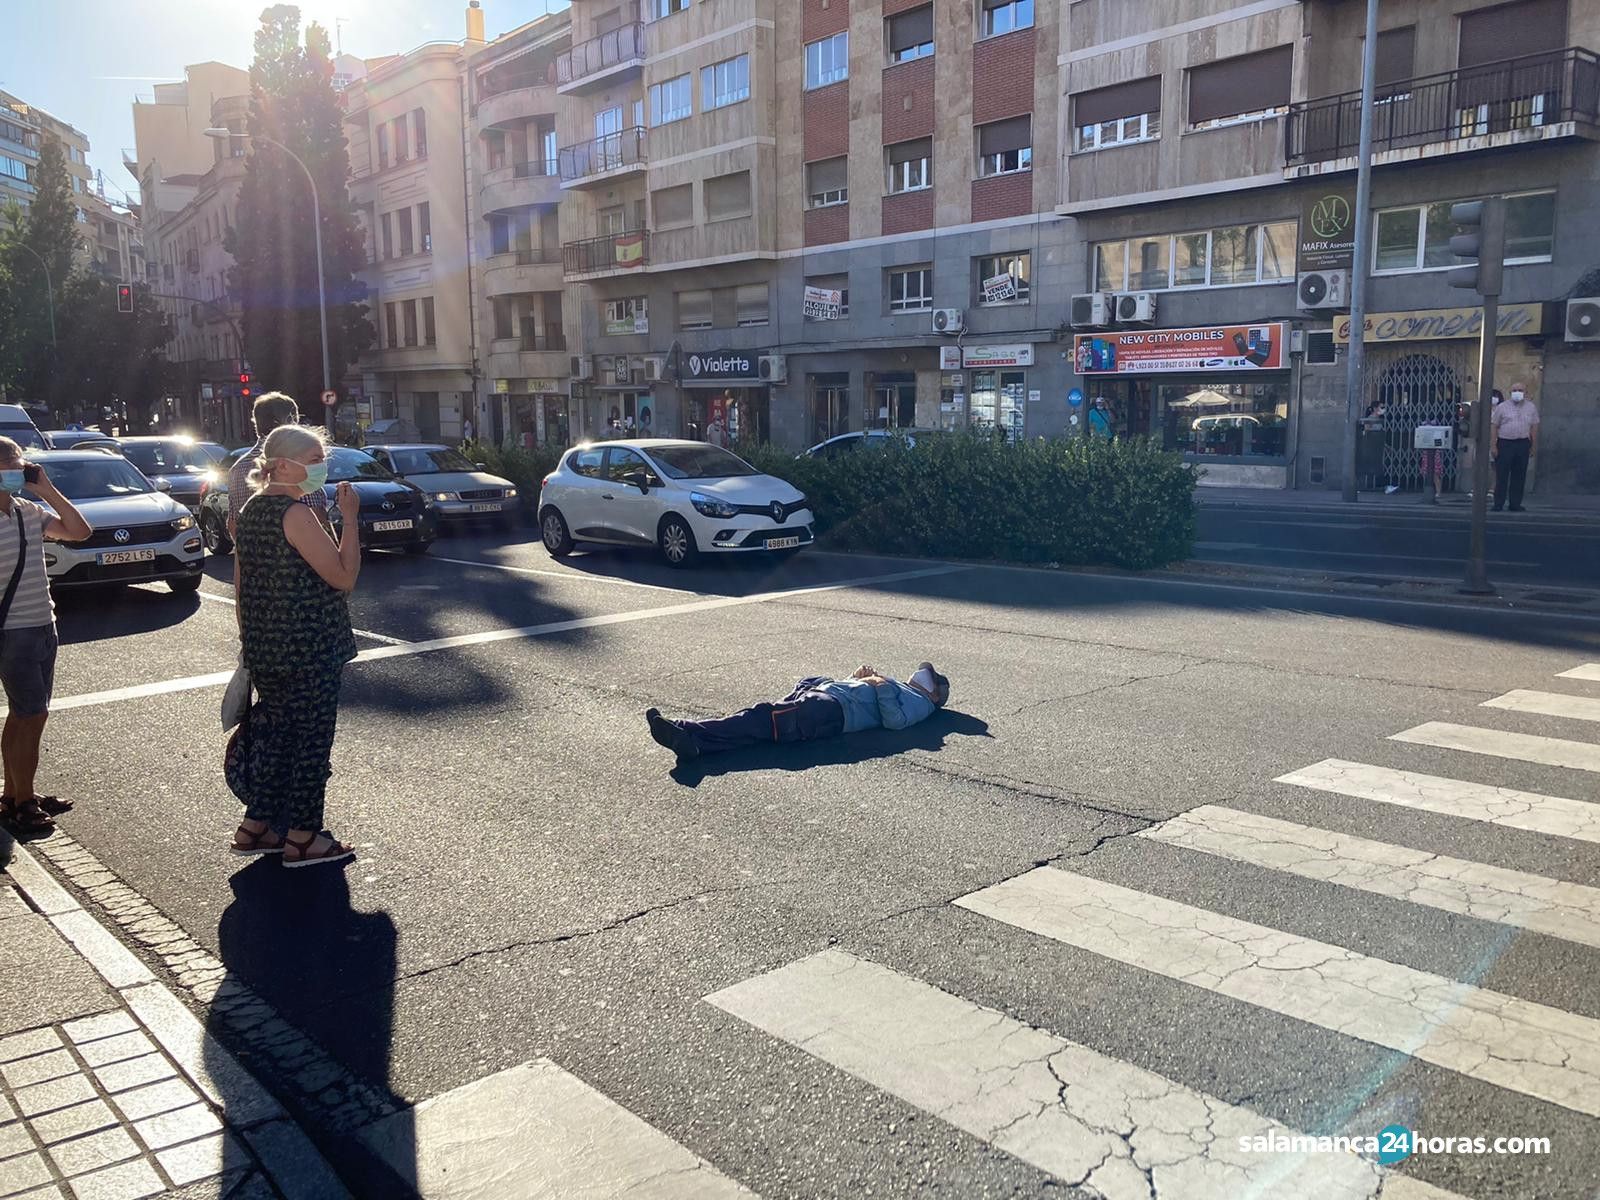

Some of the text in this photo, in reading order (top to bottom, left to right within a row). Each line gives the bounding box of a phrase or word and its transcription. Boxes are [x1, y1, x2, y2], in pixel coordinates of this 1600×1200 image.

[1302, 241, 1329, 252] MAFIX
[986, 283, 1009, 295] VENDE
[804, 300, 839, 312] ALQUILA
[1119, 330, 1225, 345] NEW CITY MOBILES
[702, 356, 749, 372] Violetta
[104, 550, 153, 564] 2752 LFS
